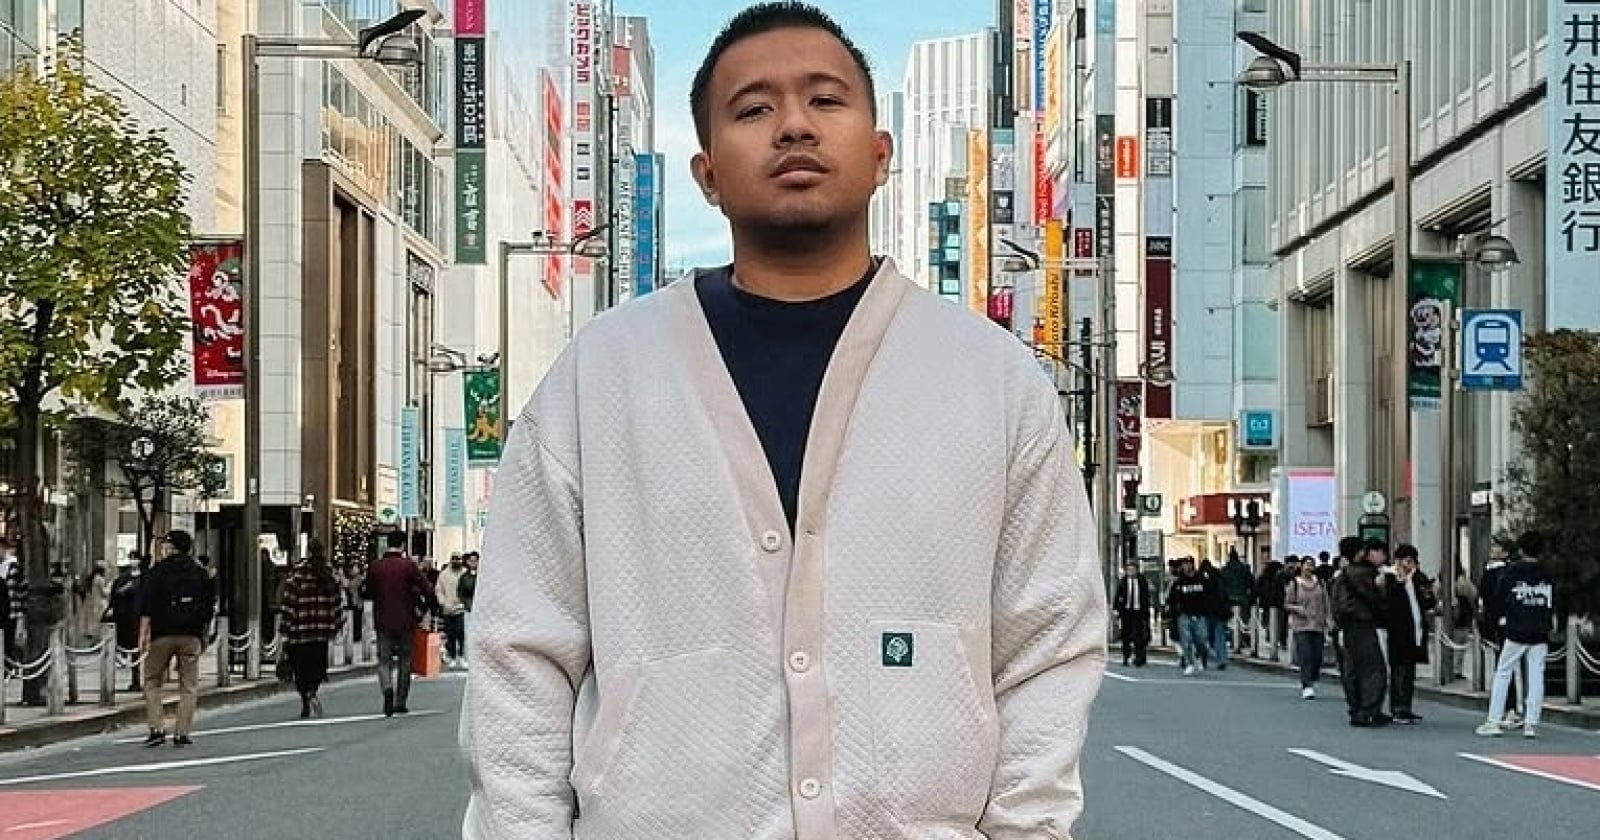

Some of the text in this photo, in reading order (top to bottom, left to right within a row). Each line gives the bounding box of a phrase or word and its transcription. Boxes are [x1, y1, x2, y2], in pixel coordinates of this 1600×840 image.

[1561, 0, 1600, 252] 井住友銀行
